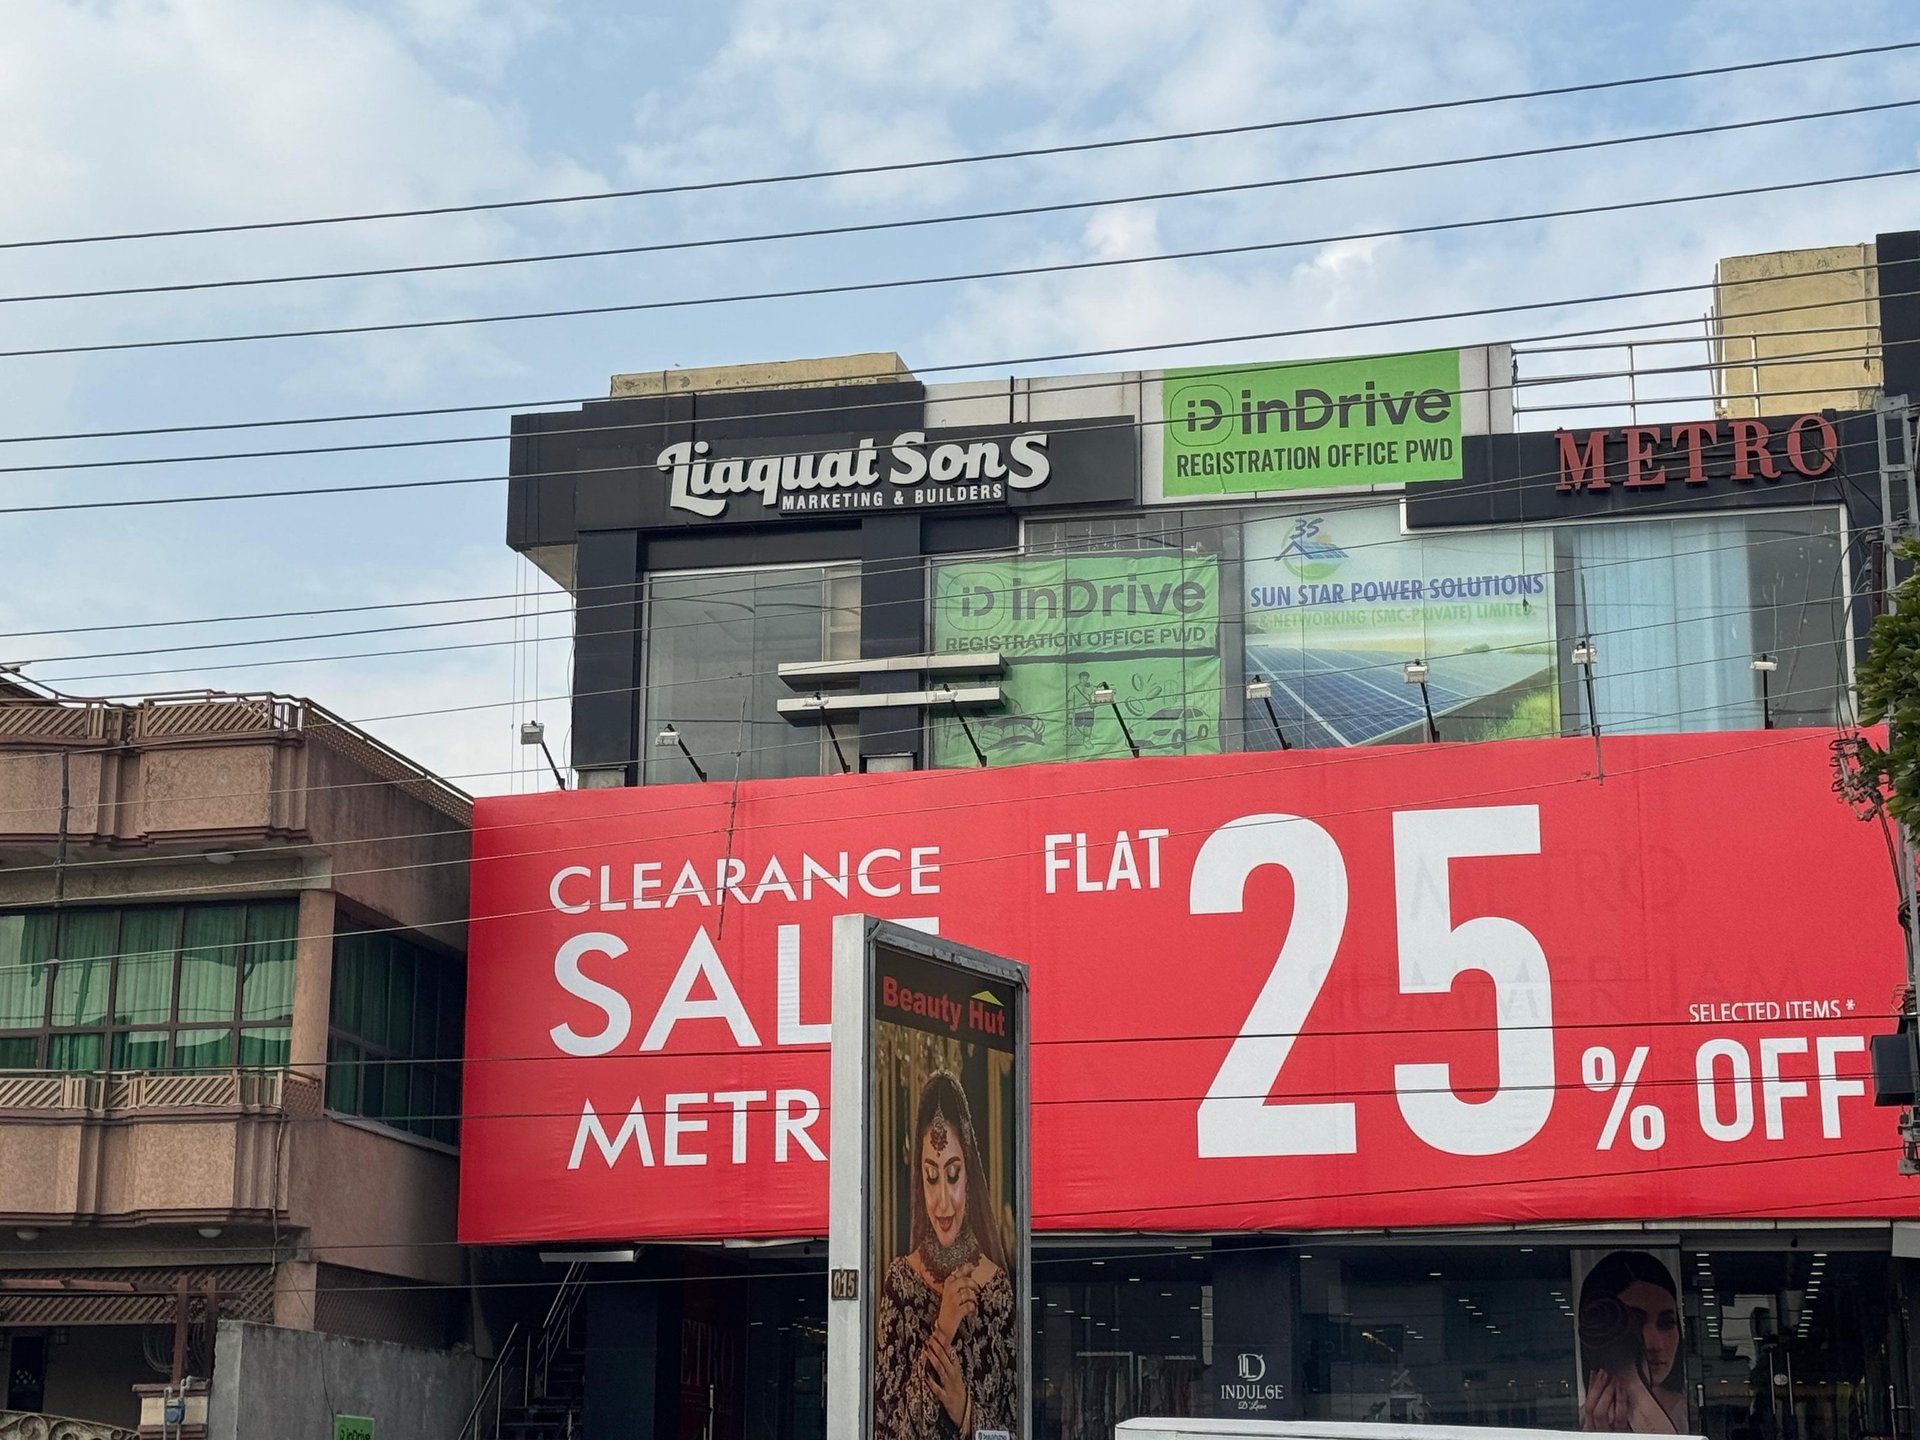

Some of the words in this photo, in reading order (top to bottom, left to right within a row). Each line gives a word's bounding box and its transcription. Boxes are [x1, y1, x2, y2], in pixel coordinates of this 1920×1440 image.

[1241, 381, 1452, 435] inDrive
[1176, 446, 1320, 477] REGISTRATION
[1328, 441, 1398, 468] OFFICE
[1406, 437, 1452, 464] PWD
[1553, 414, 1838, 491] METRO
[656, 438, 880, 517] Liaquat
[782, 492, 883, 510] MARKETING
[894, 493, 904, 505] &
[915, 484, 1002, 504] BUILDERS
[1012, 573, 1206, 621] inDrive
[1250, 586, 1291, 608] SUN
[1298, 584, 1344, 605] STAR
[1351, 579, 1423, 602] POWER
[1429, 574, 1544, 599] SOLUTIONS
[946, 632, 1082, 651] REGISTRATION
[1087, 629, 1155, 646] OFFICE
[1160, 627, 1206, 643] PWD
[1274, 610, 1366, 628] NETWORKING
[549, 846, 940, 915] CLEARANCE
[549, 917, 940, 1057] SAL
[883, 975, 962, 1032] Beauty
[969, 1000, 1005, 1037] Hut
[1045, 828, 1169, 894] FLAT
[1696, 1035, 1866, 1142] OFF
[1689, 1001, 1780, 1022] SELECTED
[567, 1089, 829, 1171] METR
[834, 1271, 855, 1297] 015
[1220, 1384, 1284, 1399] INDULGE
